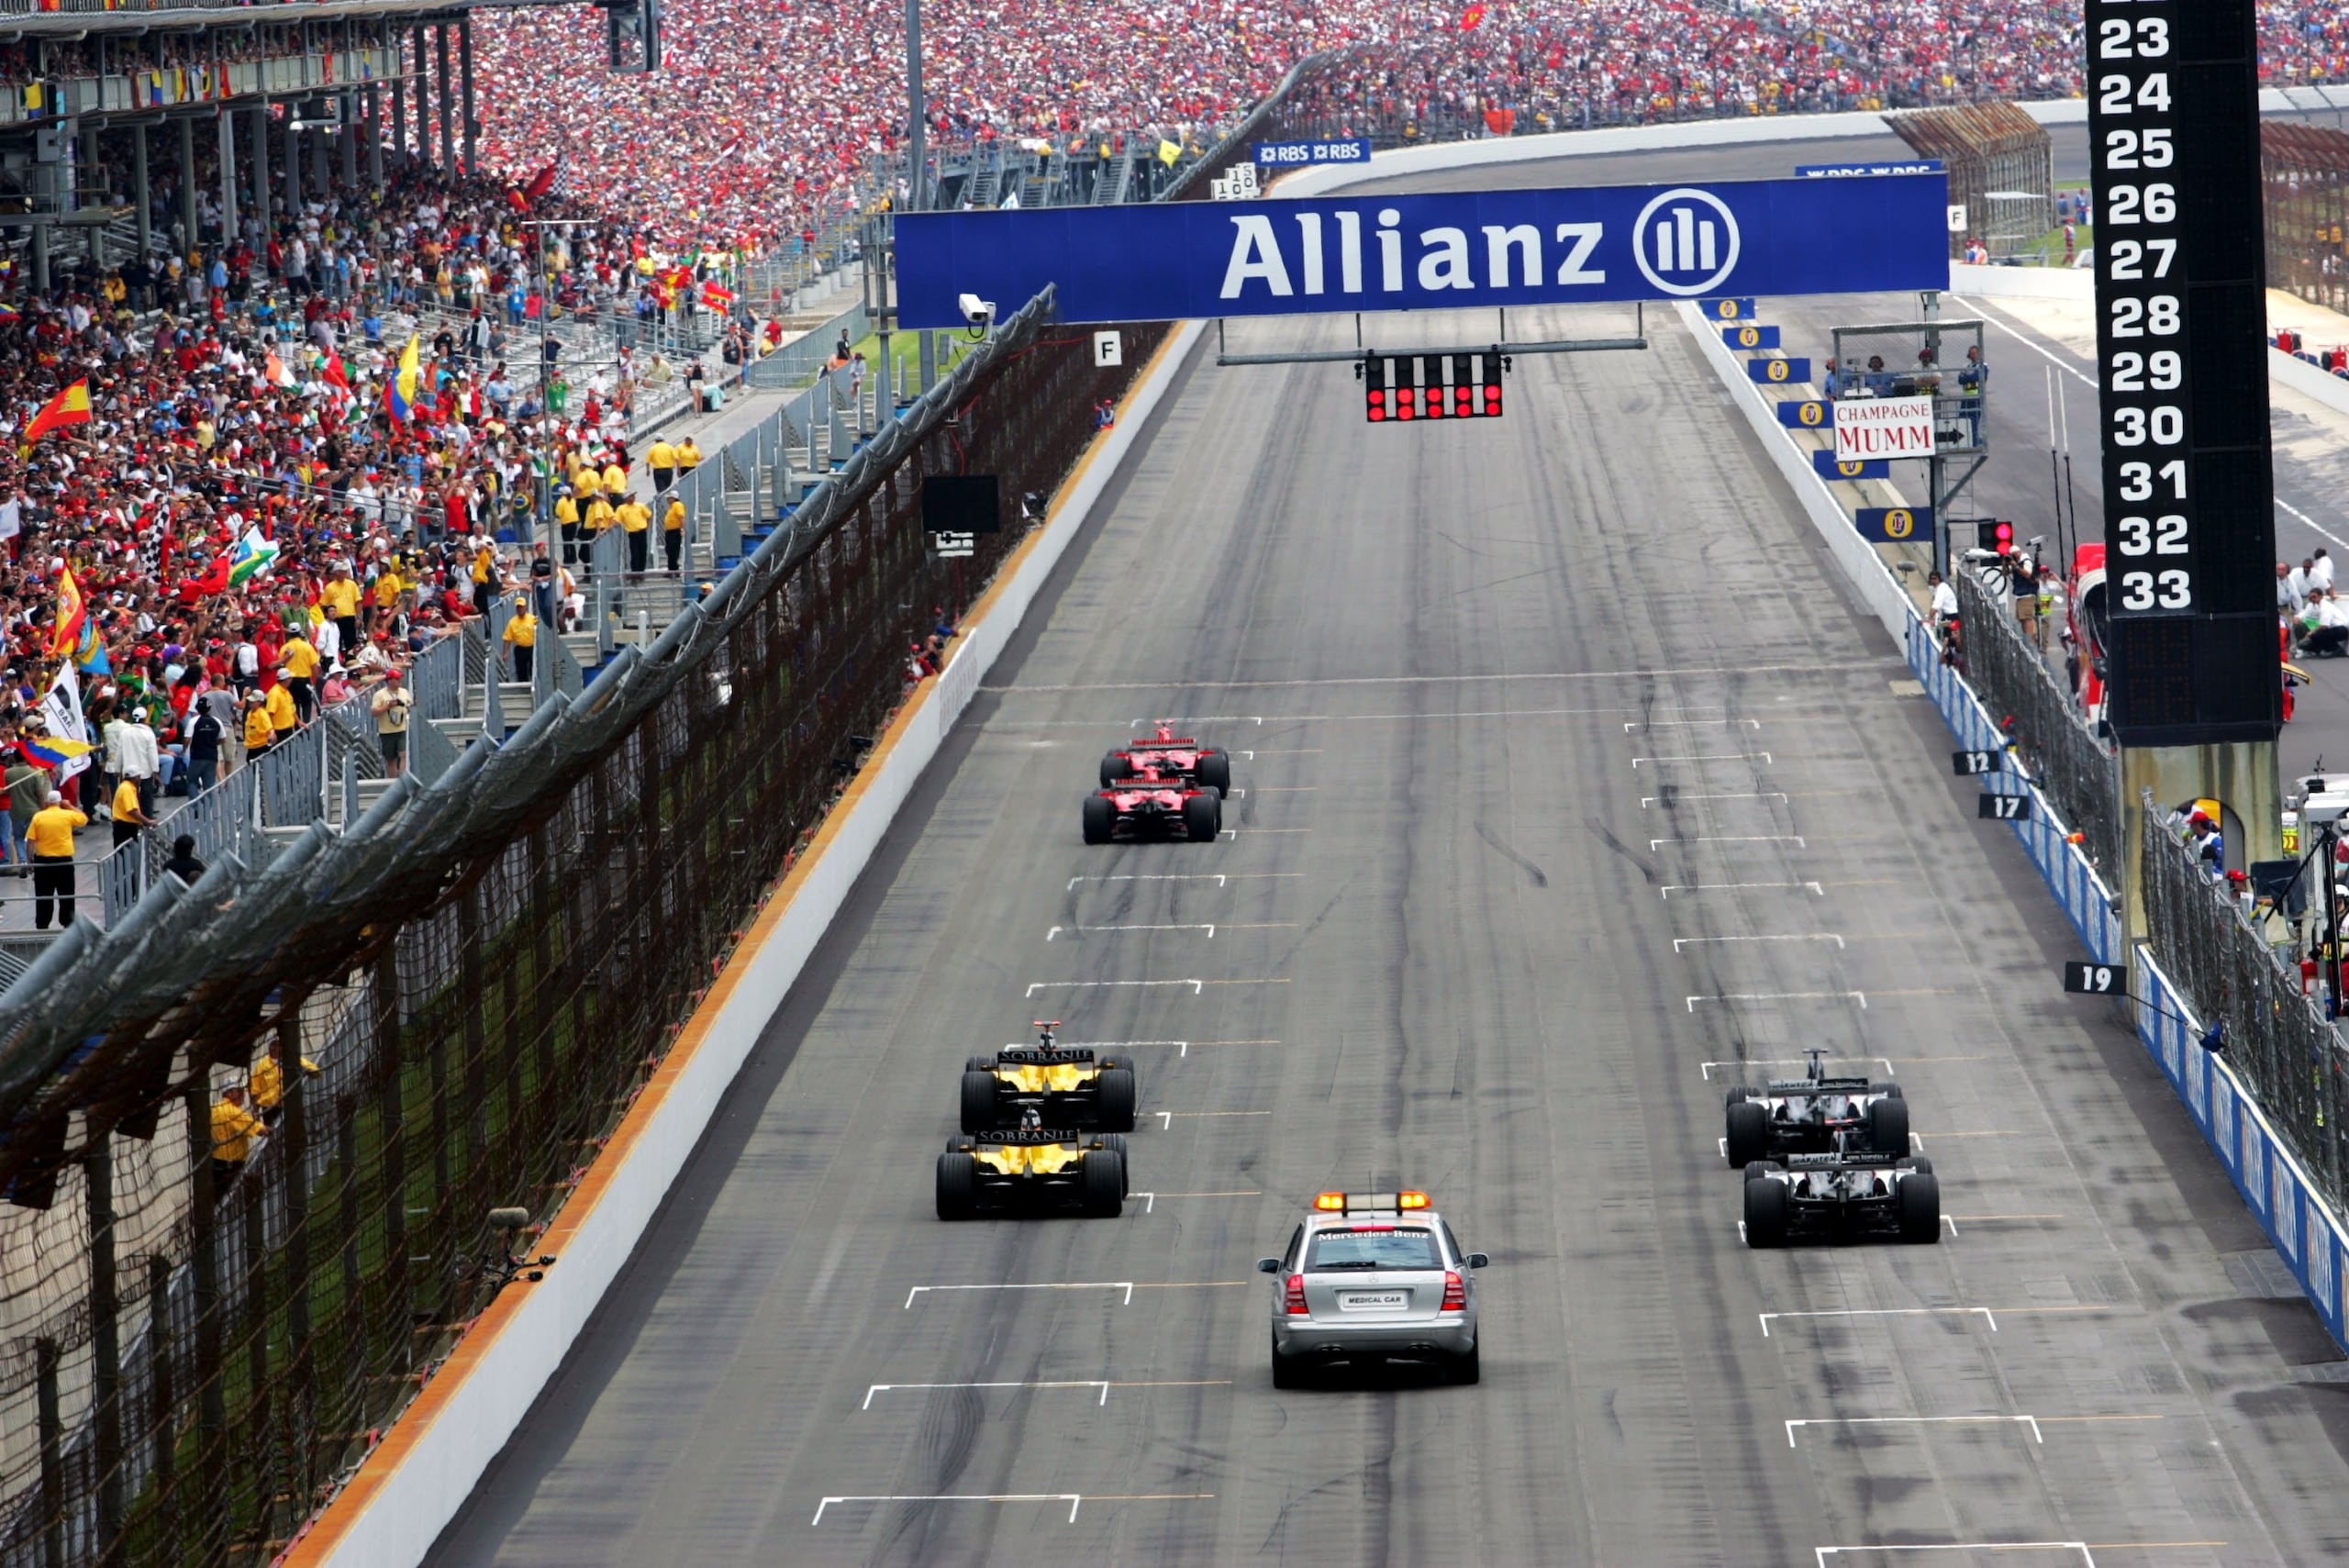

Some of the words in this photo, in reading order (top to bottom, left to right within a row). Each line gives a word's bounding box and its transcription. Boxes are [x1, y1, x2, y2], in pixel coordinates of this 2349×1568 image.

[2099, 17, 2170, 60] 23
[2099, 72, 2172, 115] 24
[1277, 145, 1309, 162] RBS
[1330, 142, 1361, 160] RBS
[2106, 128, 2174, 170] 25
[1952, 211, 1962, 225] F
[2108, 183, 2176, 225] 26
[1219, 208, 1606, 299] Allianz
[2110, 239, 2177, 280] 27
[2111, 295, 2181, 338] 28
[1101, 341, 1114, 359] F
[2111, 350, 2182, 392] 29
[1837, 403, 1930, 422] CHAMPAGNE
[2113, 406, 2184, 446] 30
[1838, 425, 1932, 454] MUMM
[2120, 460, 2187, 501] 31
[2119, 515, 2188, 556] 32
[2121, 569, 2191, 610] 33
[1966, 752, 1989, 773] 12
[1994, 795, 2020, 817] 17
[2083, 966, 2111, 992] 19
[1319, 1230, 1430, 1241] Mercedes-Benz
